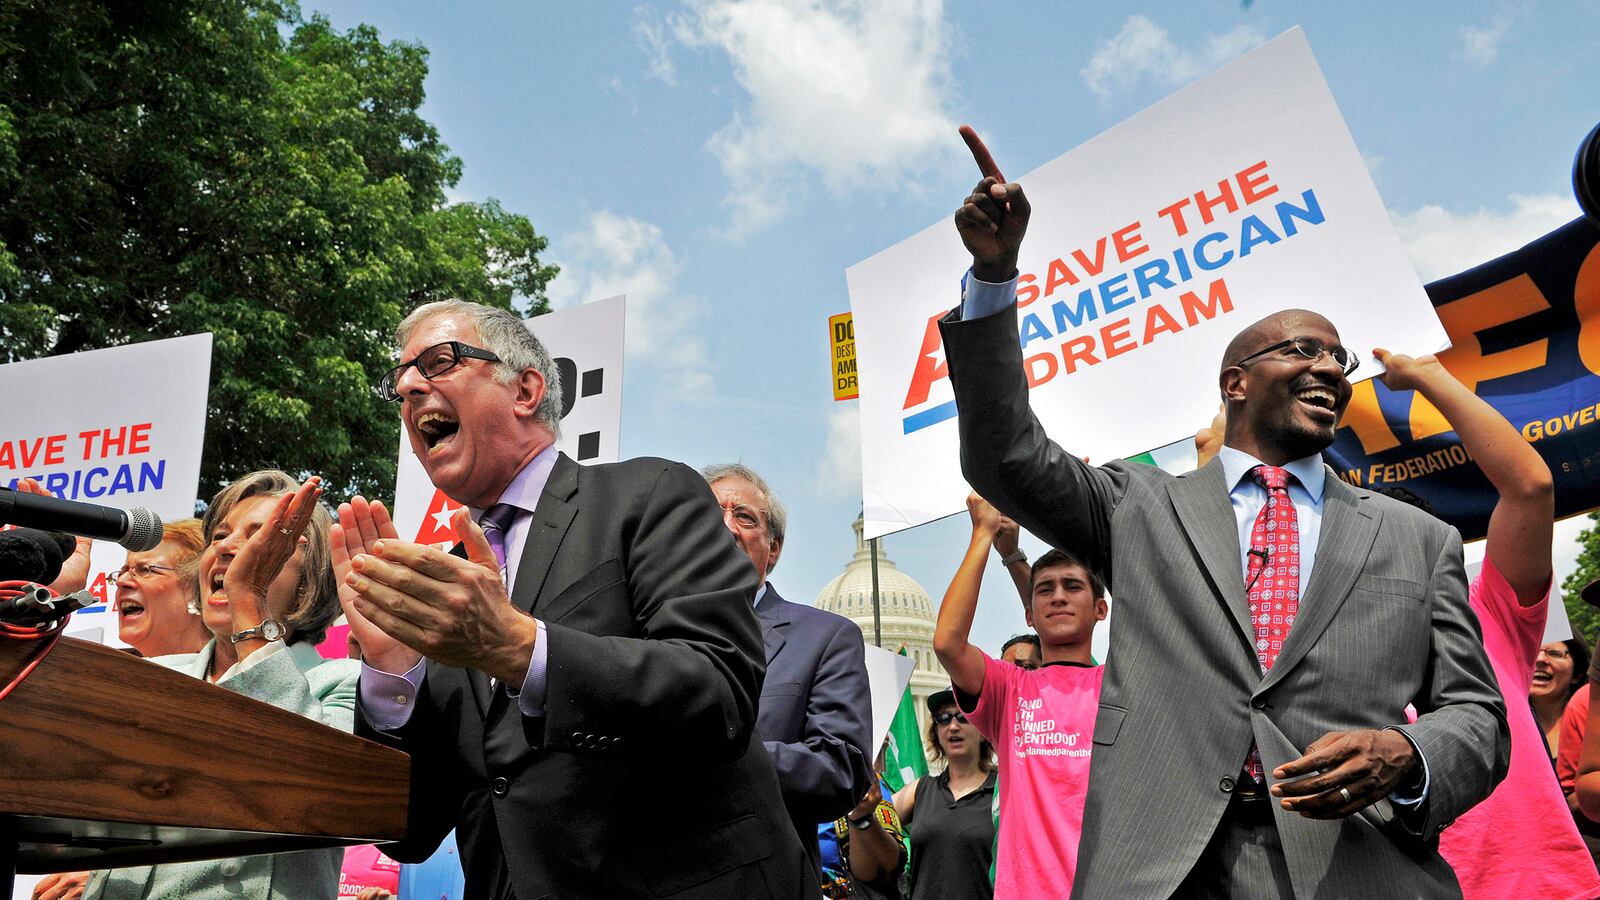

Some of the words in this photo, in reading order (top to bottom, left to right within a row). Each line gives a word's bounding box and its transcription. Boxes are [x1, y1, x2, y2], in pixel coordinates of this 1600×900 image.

[1015, 221, 1150, 309] SAVE
[1158, 160, 1279, 237] THE
[1020, 188, 1326, 350] AMERICAN
[1023, 278, 1234, 389] DREAM
[79, 423, 152, 460] THE
